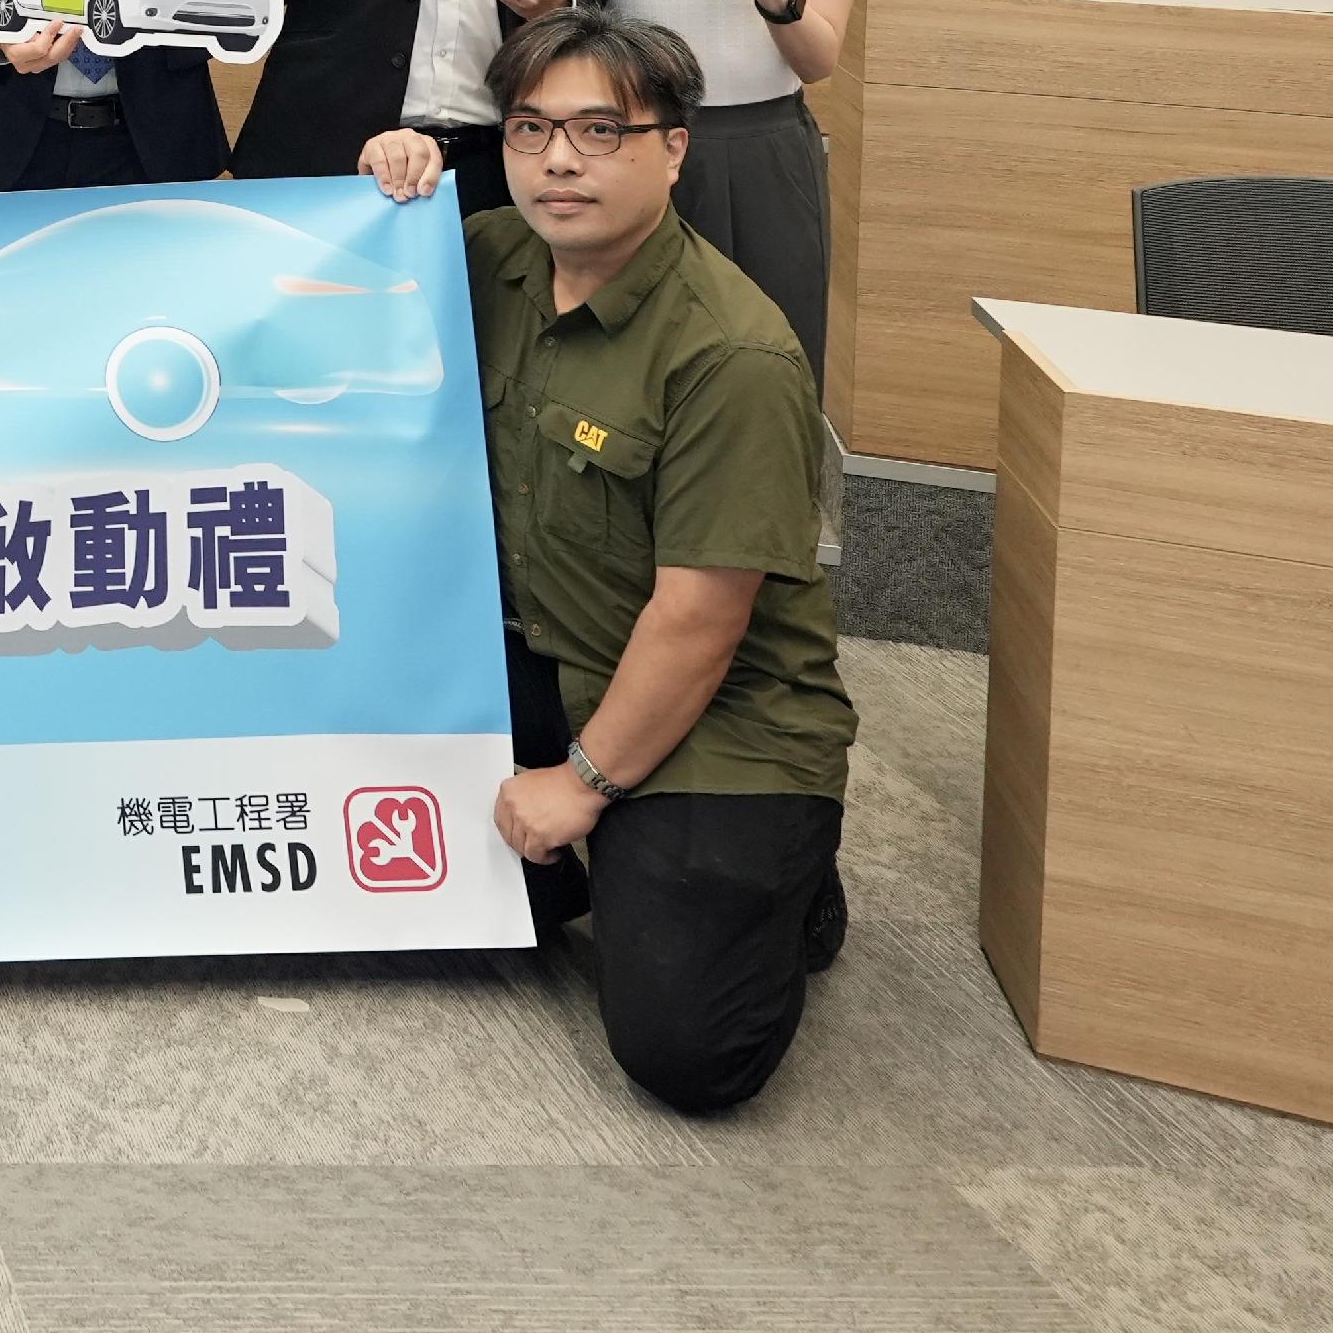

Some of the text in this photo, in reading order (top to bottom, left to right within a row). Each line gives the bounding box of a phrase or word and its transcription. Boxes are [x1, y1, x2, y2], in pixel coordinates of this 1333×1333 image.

[574, 419, 608, 452] CAT
[116, 791, 312, 836] 機電工程署
[181, 841, 318, 895] EMSD
